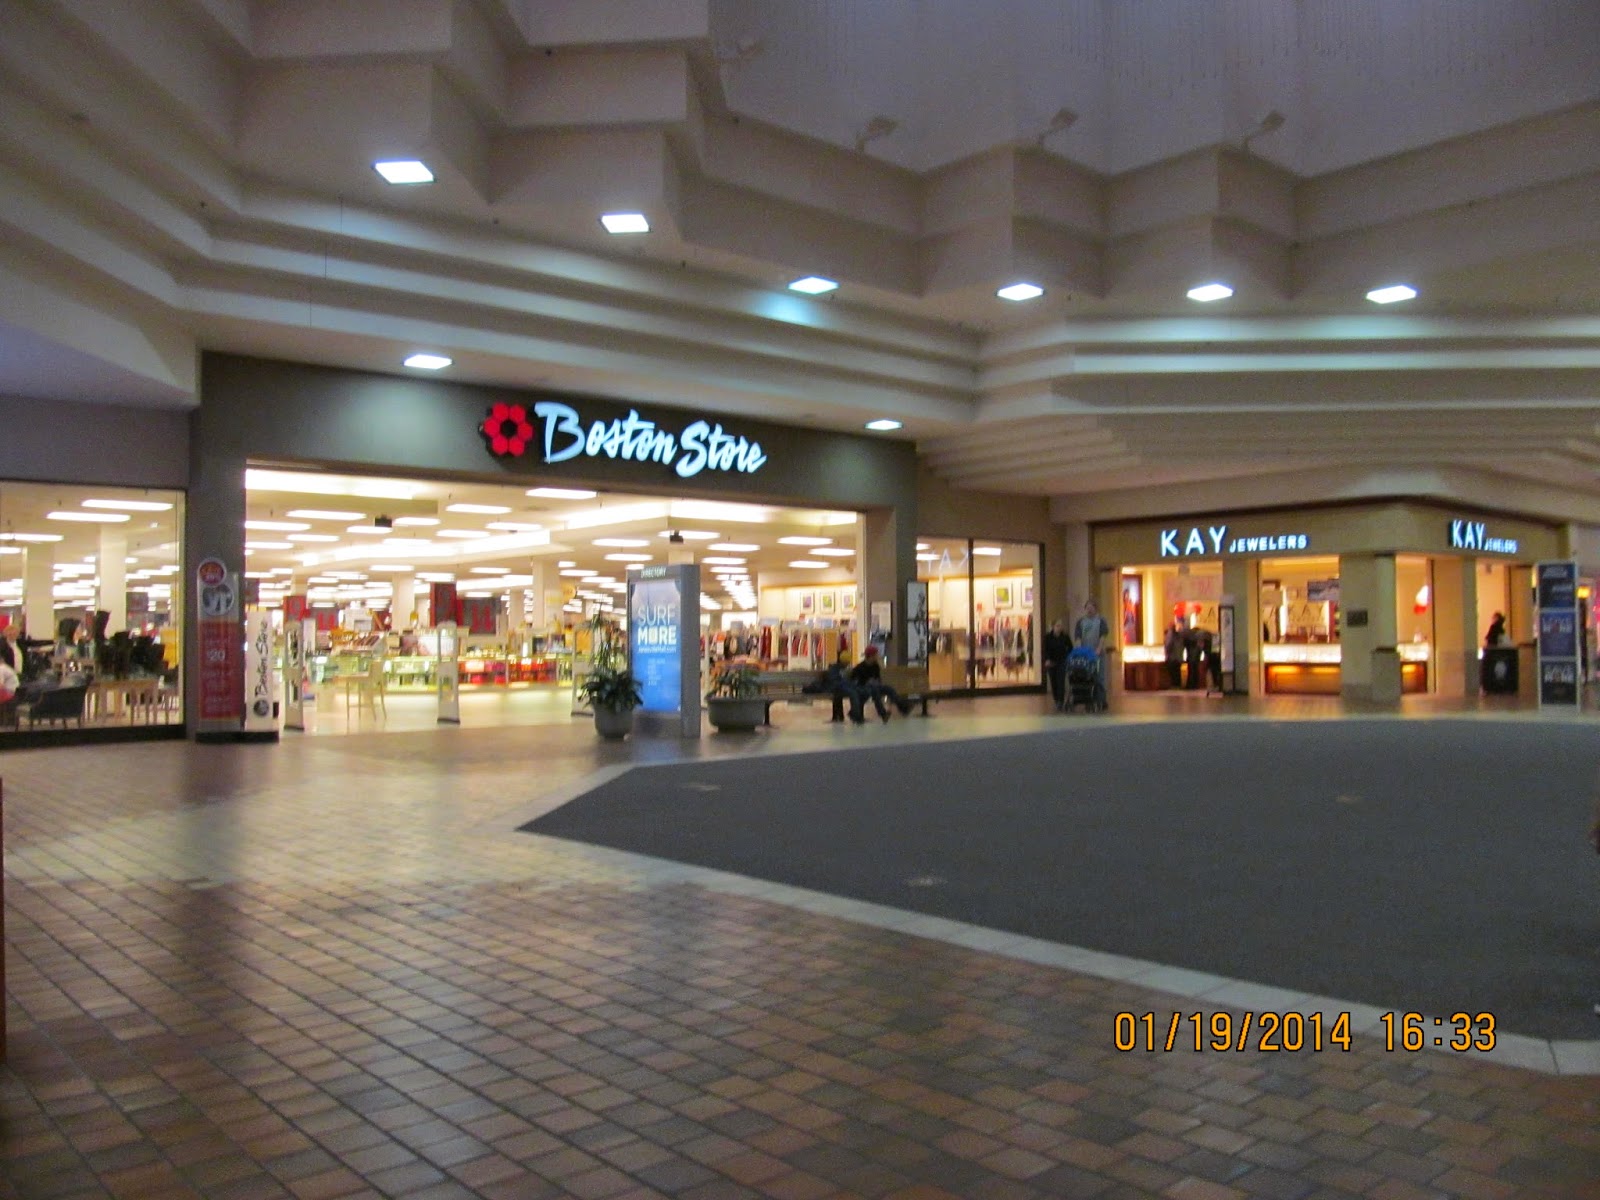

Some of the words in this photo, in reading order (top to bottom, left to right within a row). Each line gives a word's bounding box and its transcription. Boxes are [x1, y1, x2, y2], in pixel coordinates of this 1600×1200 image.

[534, 401, 677, 464] Boston
[675, 419, 767, 478] Store
[1161, 526, 1226, 557] KAY
[1229, 535, 1308, 553] JEWELERS
[1452, 519, 1485, 550] KAY
[637, 603, 676, 626] SURF
[637, 625, 677, 646] MORE
